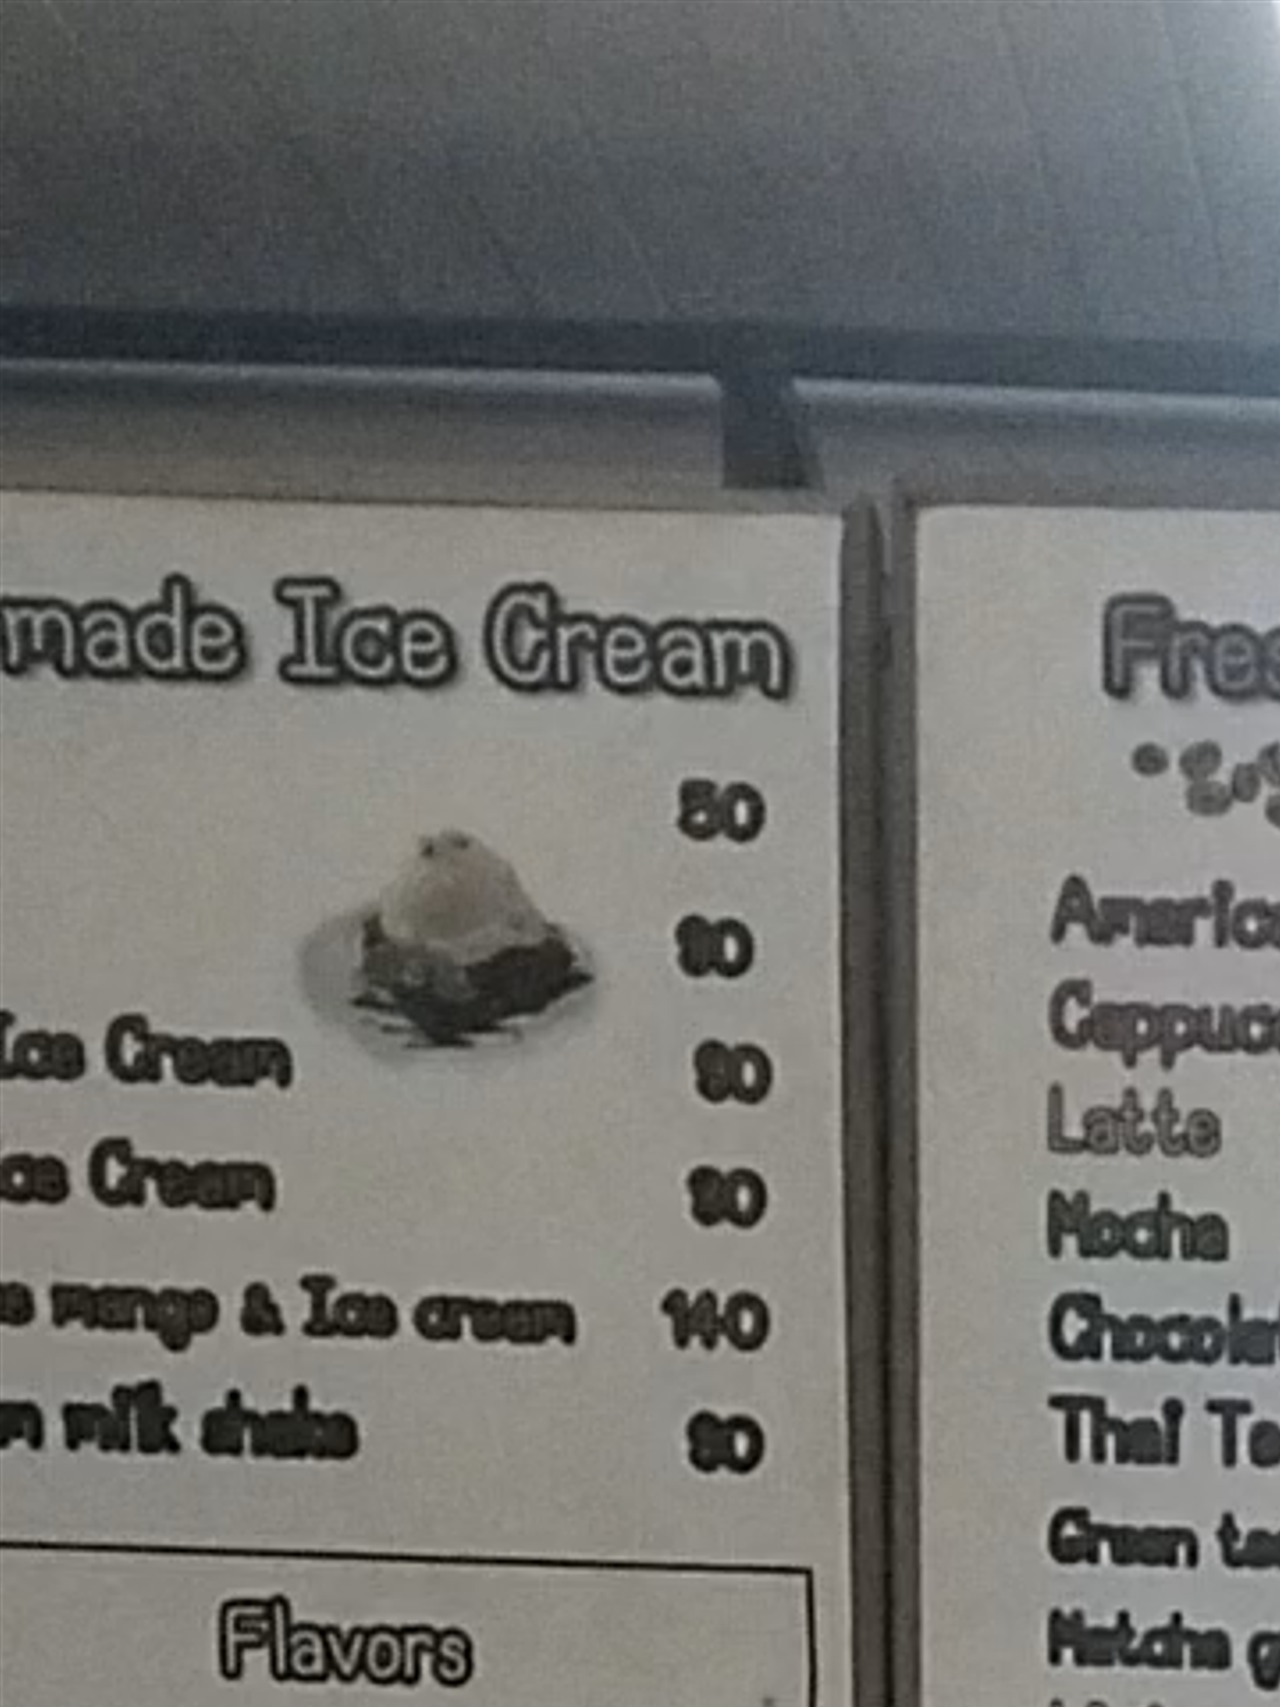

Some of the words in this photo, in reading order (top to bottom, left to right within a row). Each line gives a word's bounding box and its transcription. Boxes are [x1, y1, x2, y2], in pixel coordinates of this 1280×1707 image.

[0, 573, 254, 687] made
[273, 577, 464, 694] Ice
[482, 582, 796, 703] Cream
[104, 1013, 294, 1090] Cream
[1047, 1082, 1222, 1159] Latte
[87, 1136, 277, 1214] Cream
[1047, 1189, 1229, 1263] Mocha
[48, 1282, 220, 1353] mango
[239, 1281, 287, 1337] &
[298, 1274, 400, 1340] Ice
[660, 1288, 771, 1353] 140
[1047, 1394, 1185, 1466] Thai
[1048, 1506, 1200, 1569] Green
[218, 1593, 475, 1688] Flavors
[1047, 1607, 1232, 1671] Matcha
